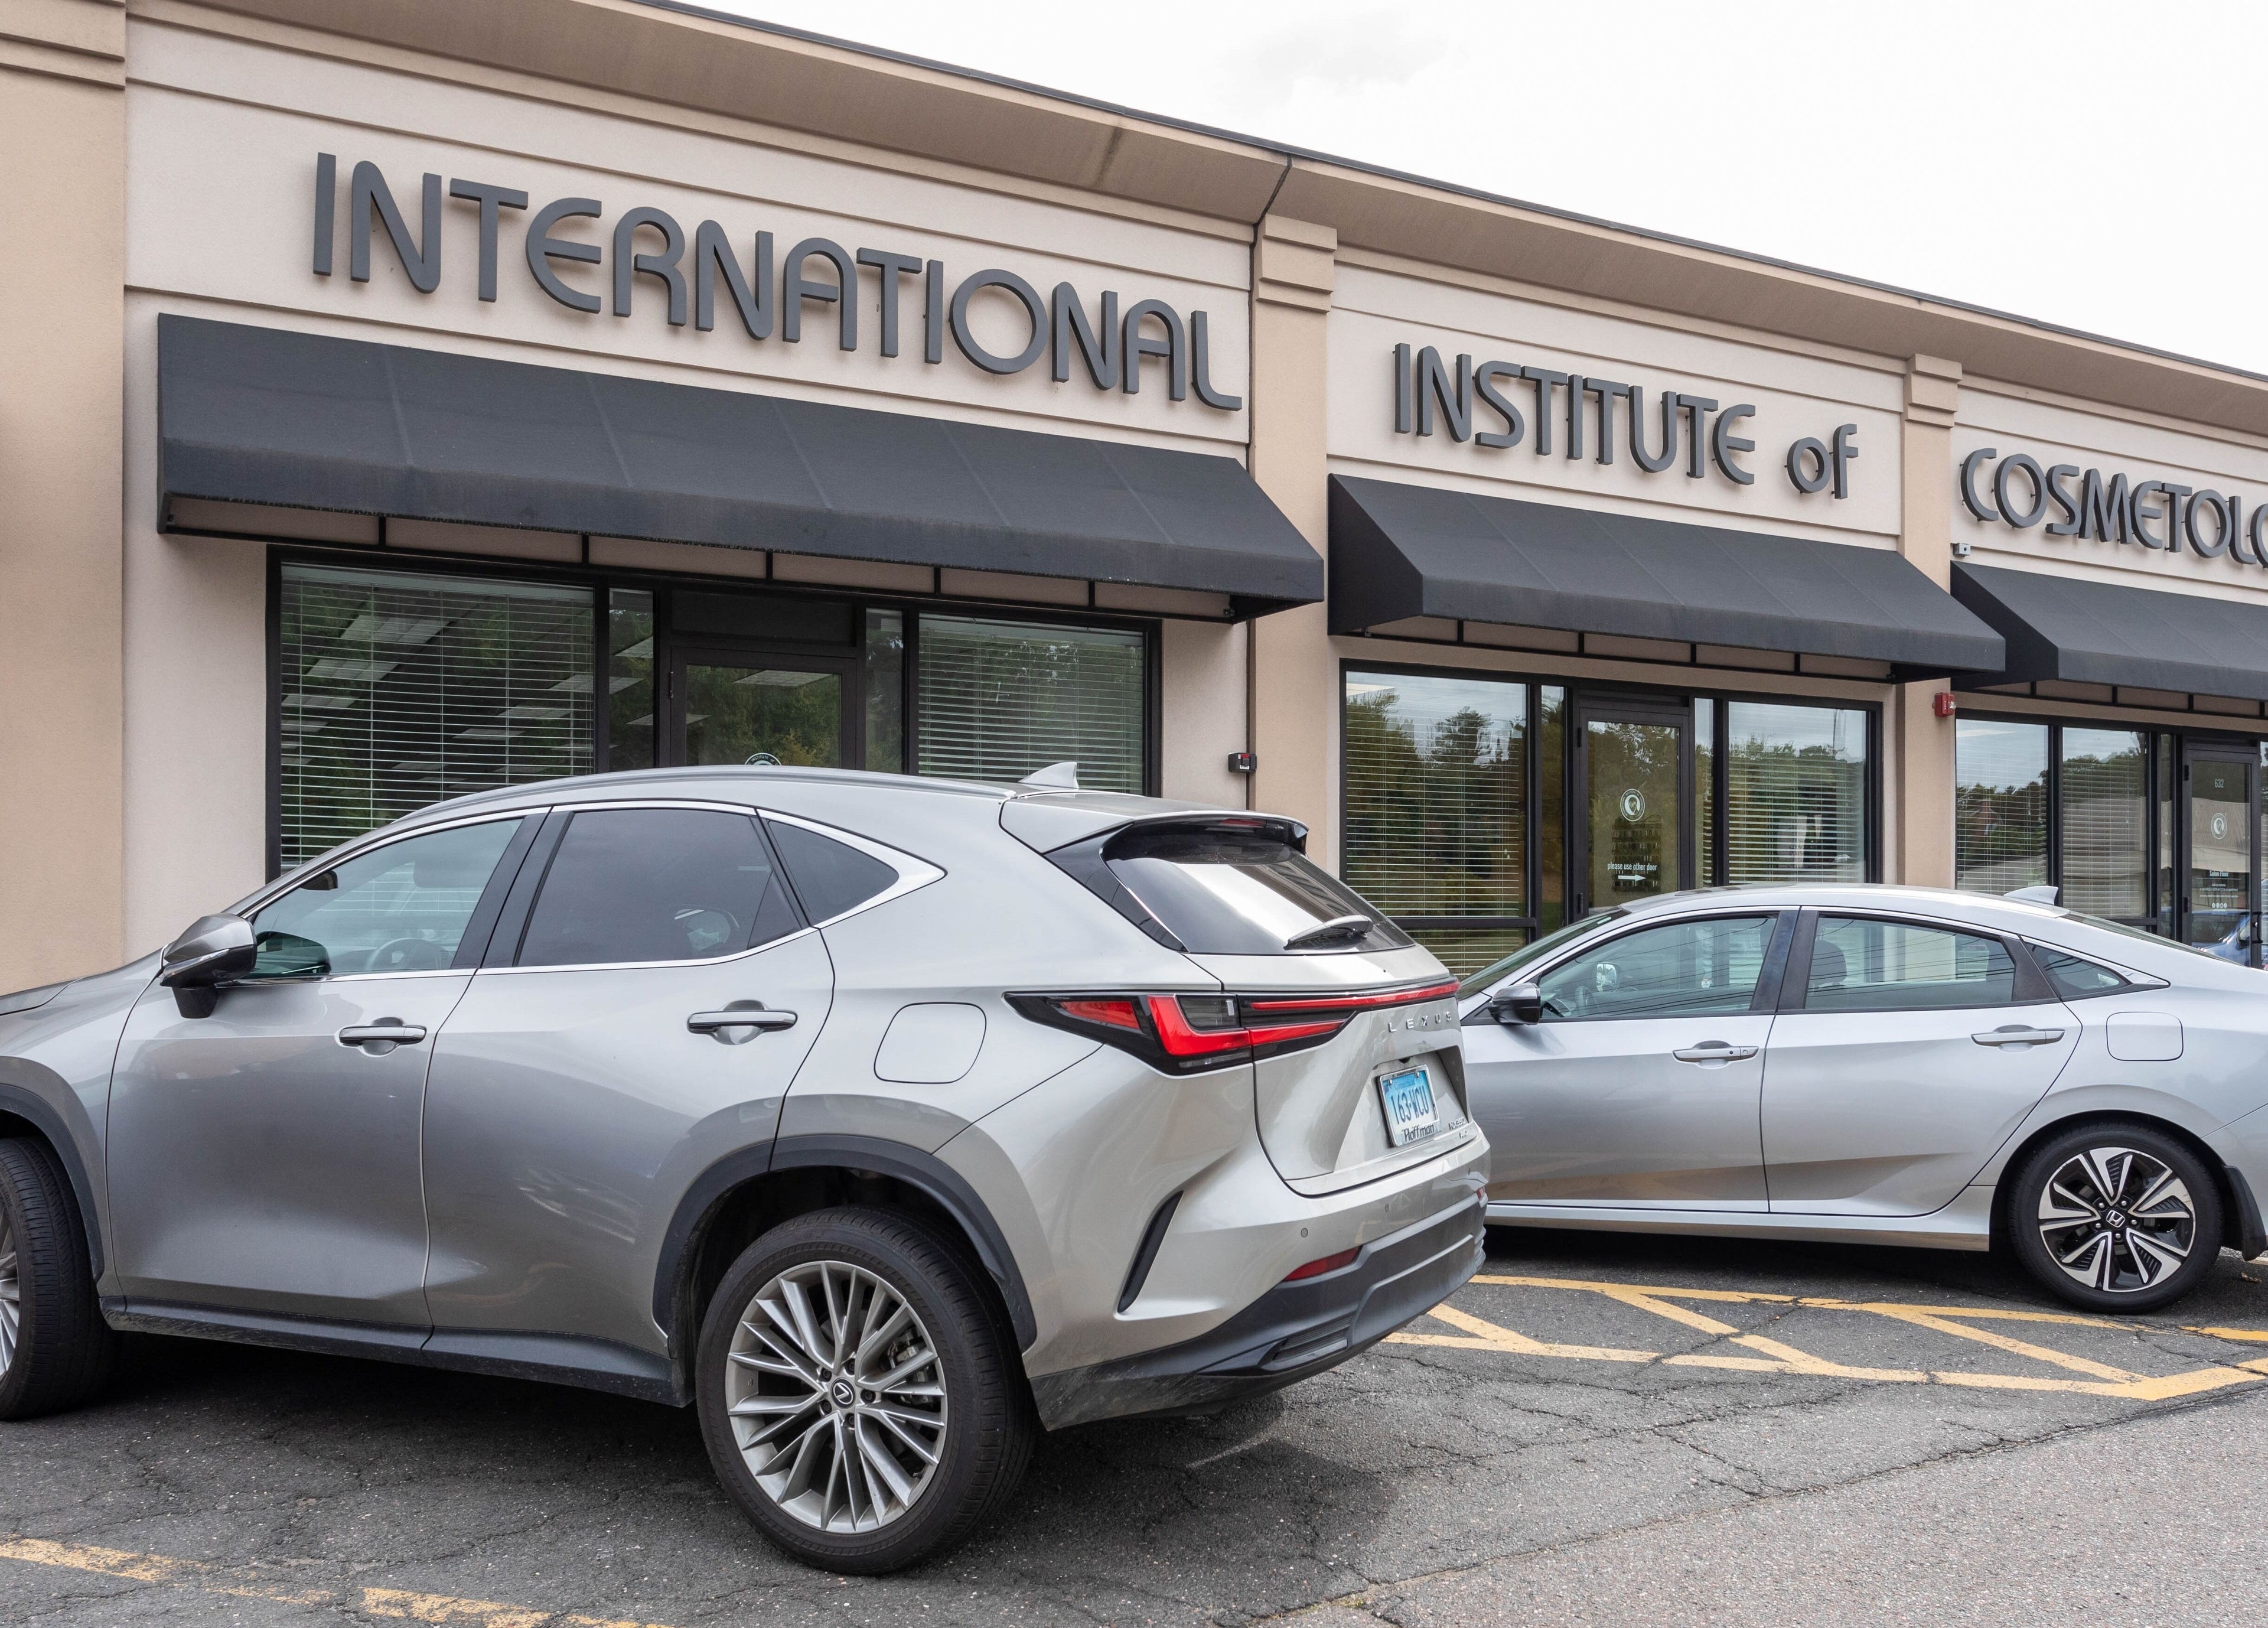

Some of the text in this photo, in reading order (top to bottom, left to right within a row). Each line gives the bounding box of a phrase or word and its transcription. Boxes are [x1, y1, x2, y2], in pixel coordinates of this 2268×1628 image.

[312, 152, 1243, 413] INTERNATIONAL
[1393, 343, 1757, 486] INSTITUTE
[1786, 423, 1859, 500] of
[2214, 779, 2225, 788] 632
[1607, 861, 1623, 871] please
[1633, 862, 1646, 871] other
[1389, 1011, 1452, 1032] LEXUS
[1404, 1124, 1435, 1142] Hoffman
